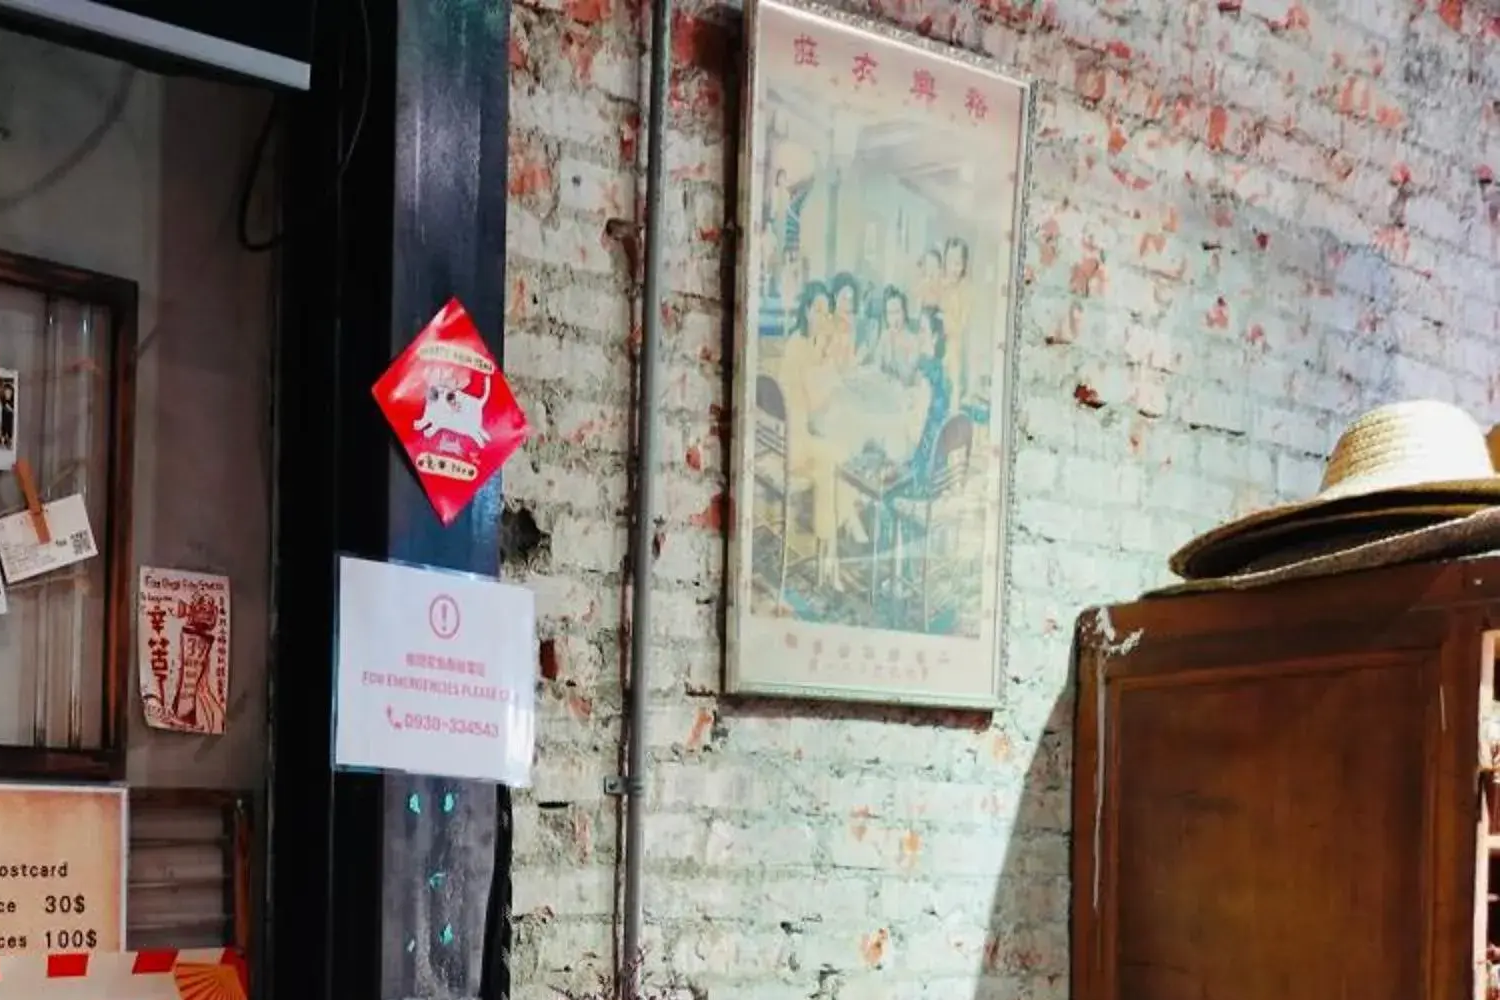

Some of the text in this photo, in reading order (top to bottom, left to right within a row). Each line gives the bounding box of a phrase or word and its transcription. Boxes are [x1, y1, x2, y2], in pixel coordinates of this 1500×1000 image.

[147, 606, 169, 706] 辛苦了
[45, 894, 86, 914] 30$
[44, 929, 98, 950] 100$
